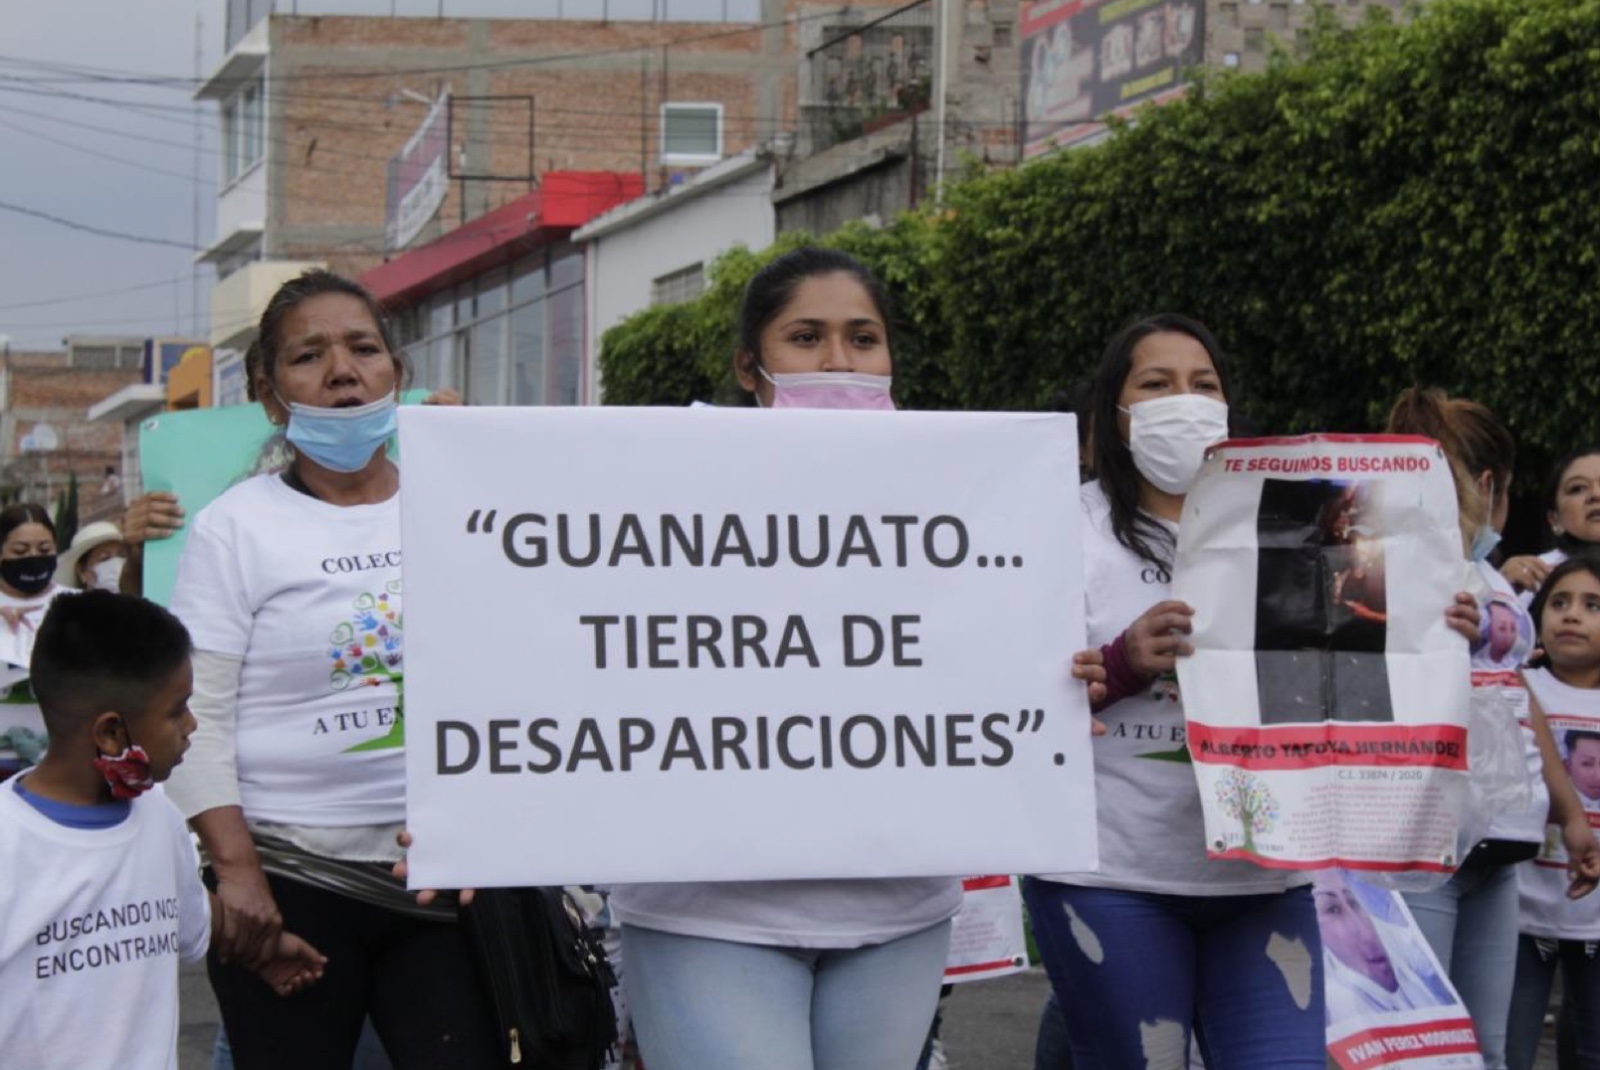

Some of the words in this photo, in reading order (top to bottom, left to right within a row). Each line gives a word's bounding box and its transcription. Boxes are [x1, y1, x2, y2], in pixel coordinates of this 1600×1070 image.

[1224, 459, 1243, 472] TE
[1246, 456, 1332, 473] SEGUIMOS
[1337, 456, 1430, 472] BUSCANDO
[579, 614, 820, 669] TIERRA
[842, 614, 923, 668] DE
[313, 717, 328, 735] A
[335, 711, 368, 732] TU
[1113, 722, 1126, 738] A
[1133, 724, 1163, 740] TU
[1200, 739, 1276, 758] ALBERTO
[1399, 770, 1422, 780] 2020
[36, 901, 151, 946] BUSCANDO
